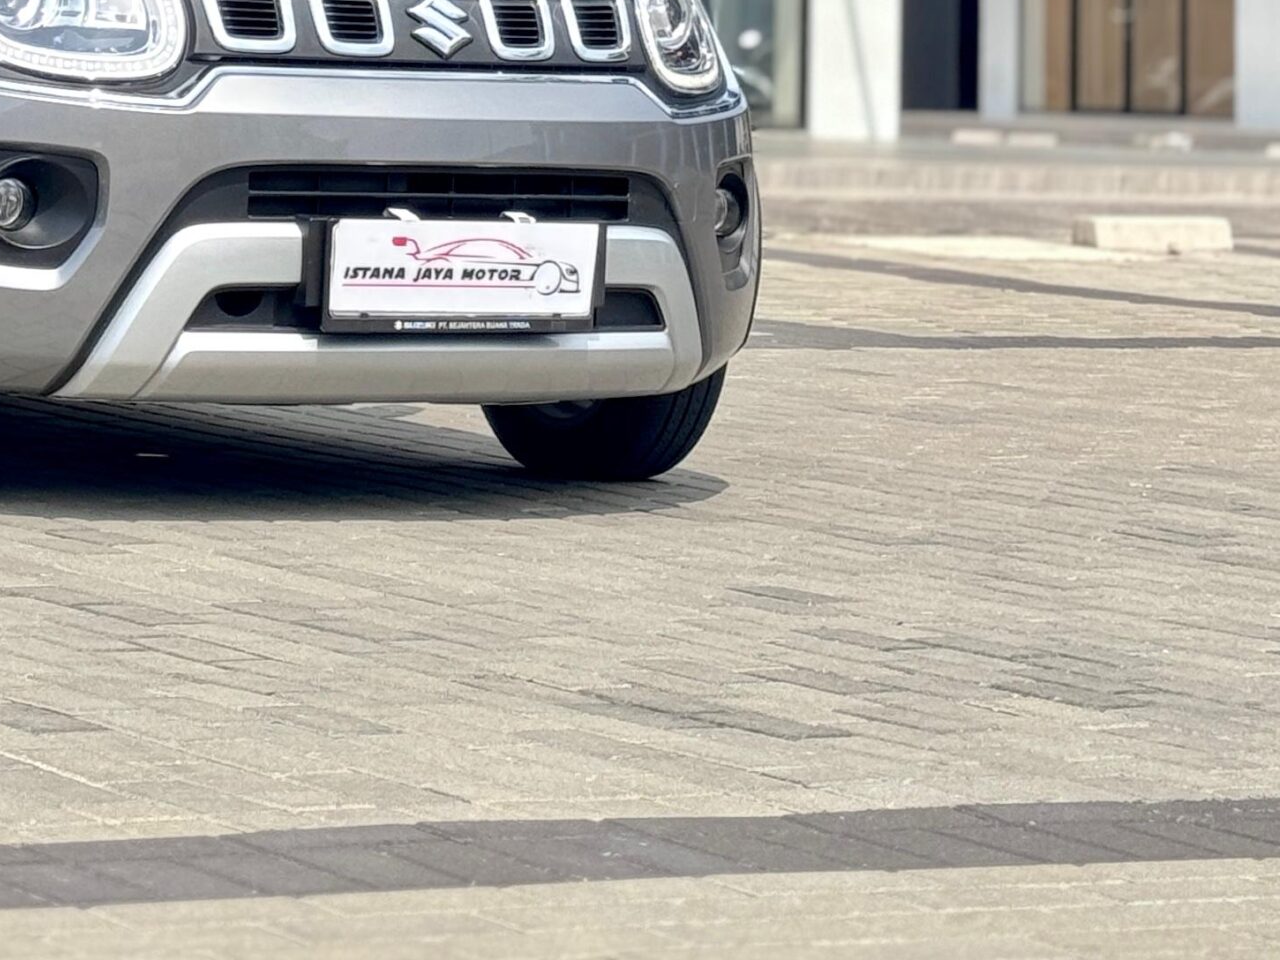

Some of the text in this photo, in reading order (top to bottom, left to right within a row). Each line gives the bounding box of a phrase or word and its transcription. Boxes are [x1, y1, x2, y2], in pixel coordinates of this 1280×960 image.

[344, 266, 522, 282] ISTANA JAYA MOTOR
